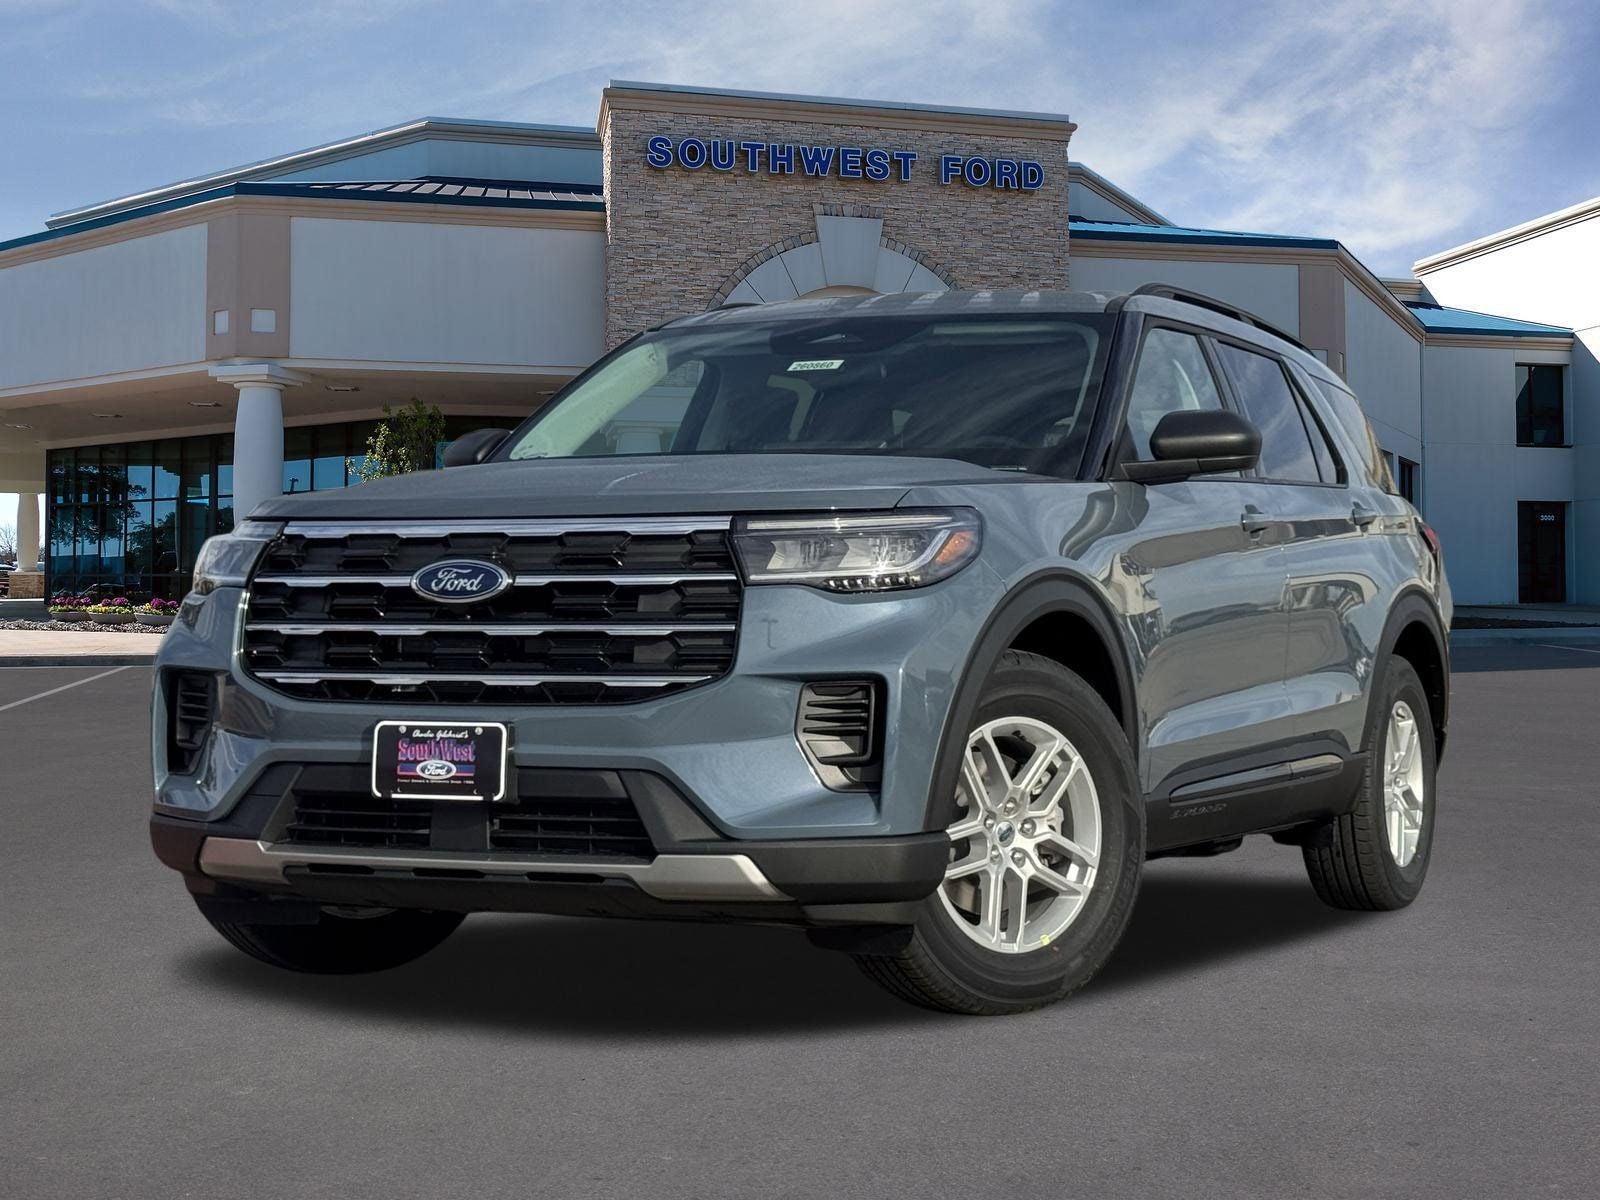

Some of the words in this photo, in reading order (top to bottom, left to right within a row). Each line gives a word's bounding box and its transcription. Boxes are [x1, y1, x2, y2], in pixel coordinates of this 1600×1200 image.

[646, 135, 918, 181] SOUTHWEST
[939, 154, 1046, 190] FORD
[431, 567, 485, 591] Ford
[424, 763, 448, 776] Ford
